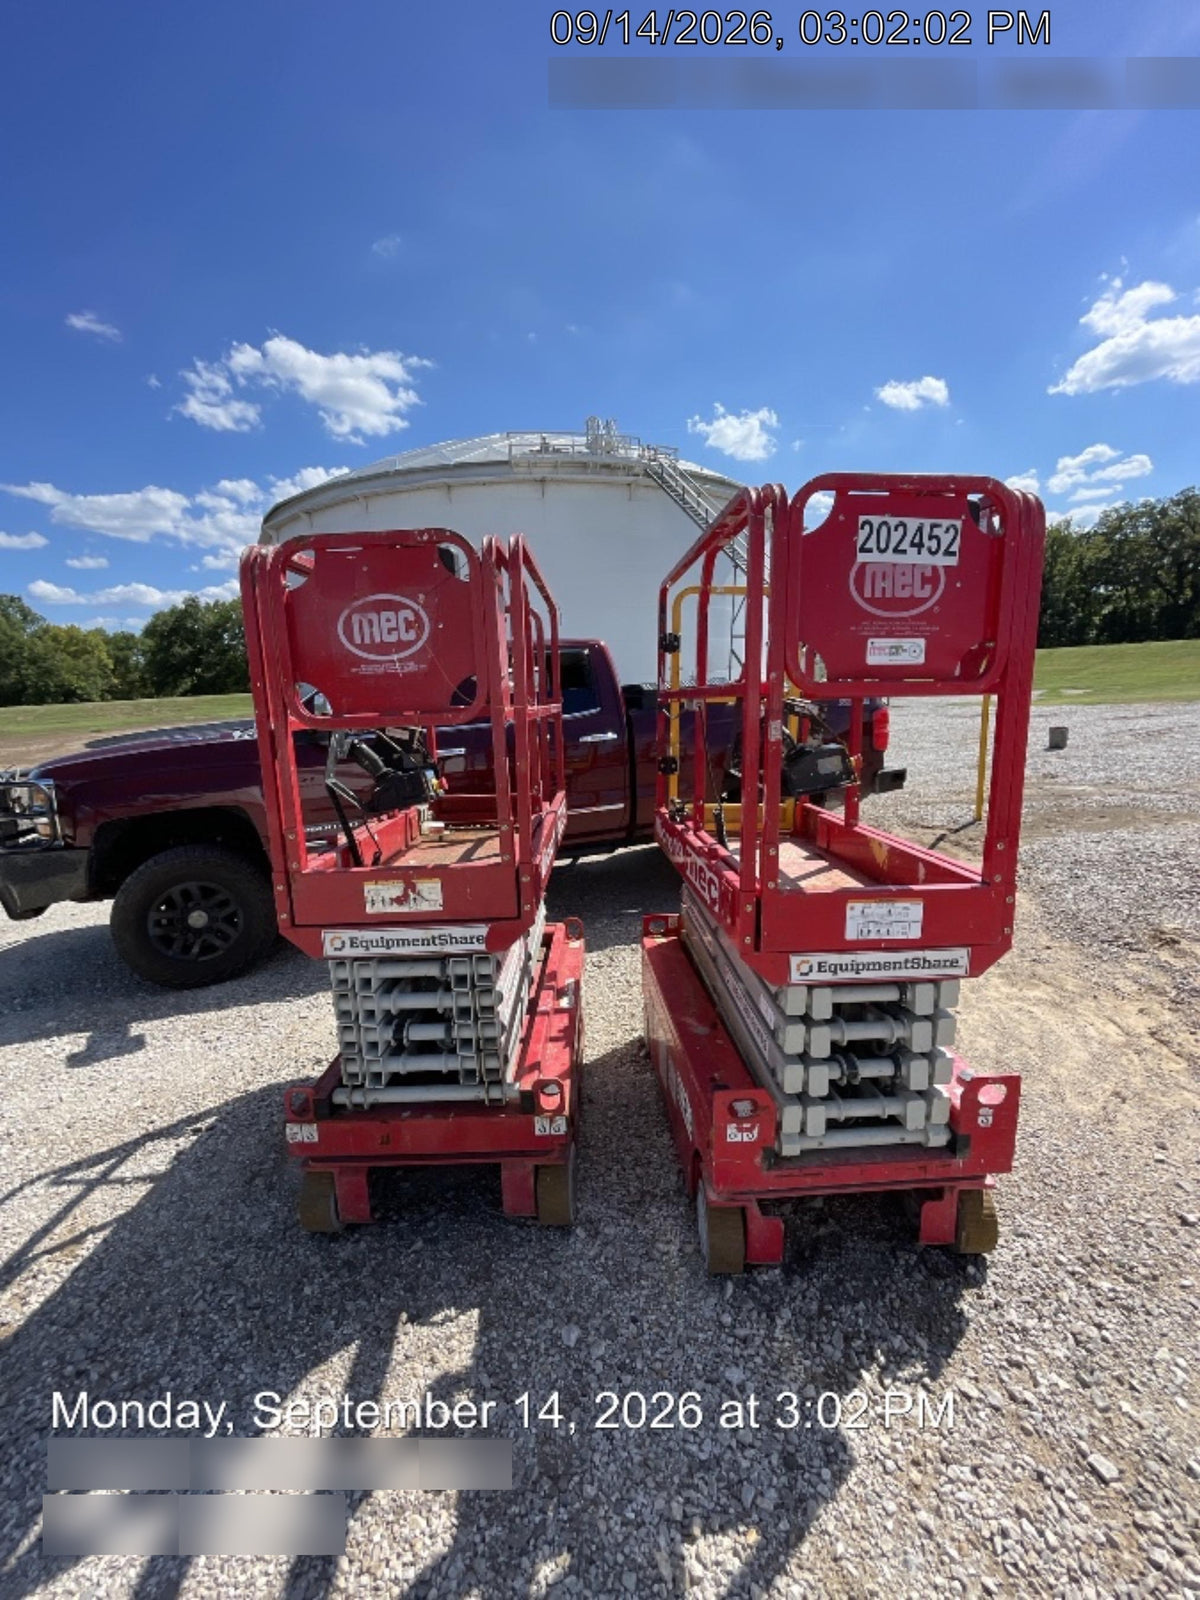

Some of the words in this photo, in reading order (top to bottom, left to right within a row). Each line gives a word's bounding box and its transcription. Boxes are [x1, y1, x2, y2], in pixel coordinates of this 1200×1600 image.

[858, 519, 960, 558] 202452
[350, 933, 485, 951] EquipmentShare
[816, 955, 960, 976] EquipmentShare
